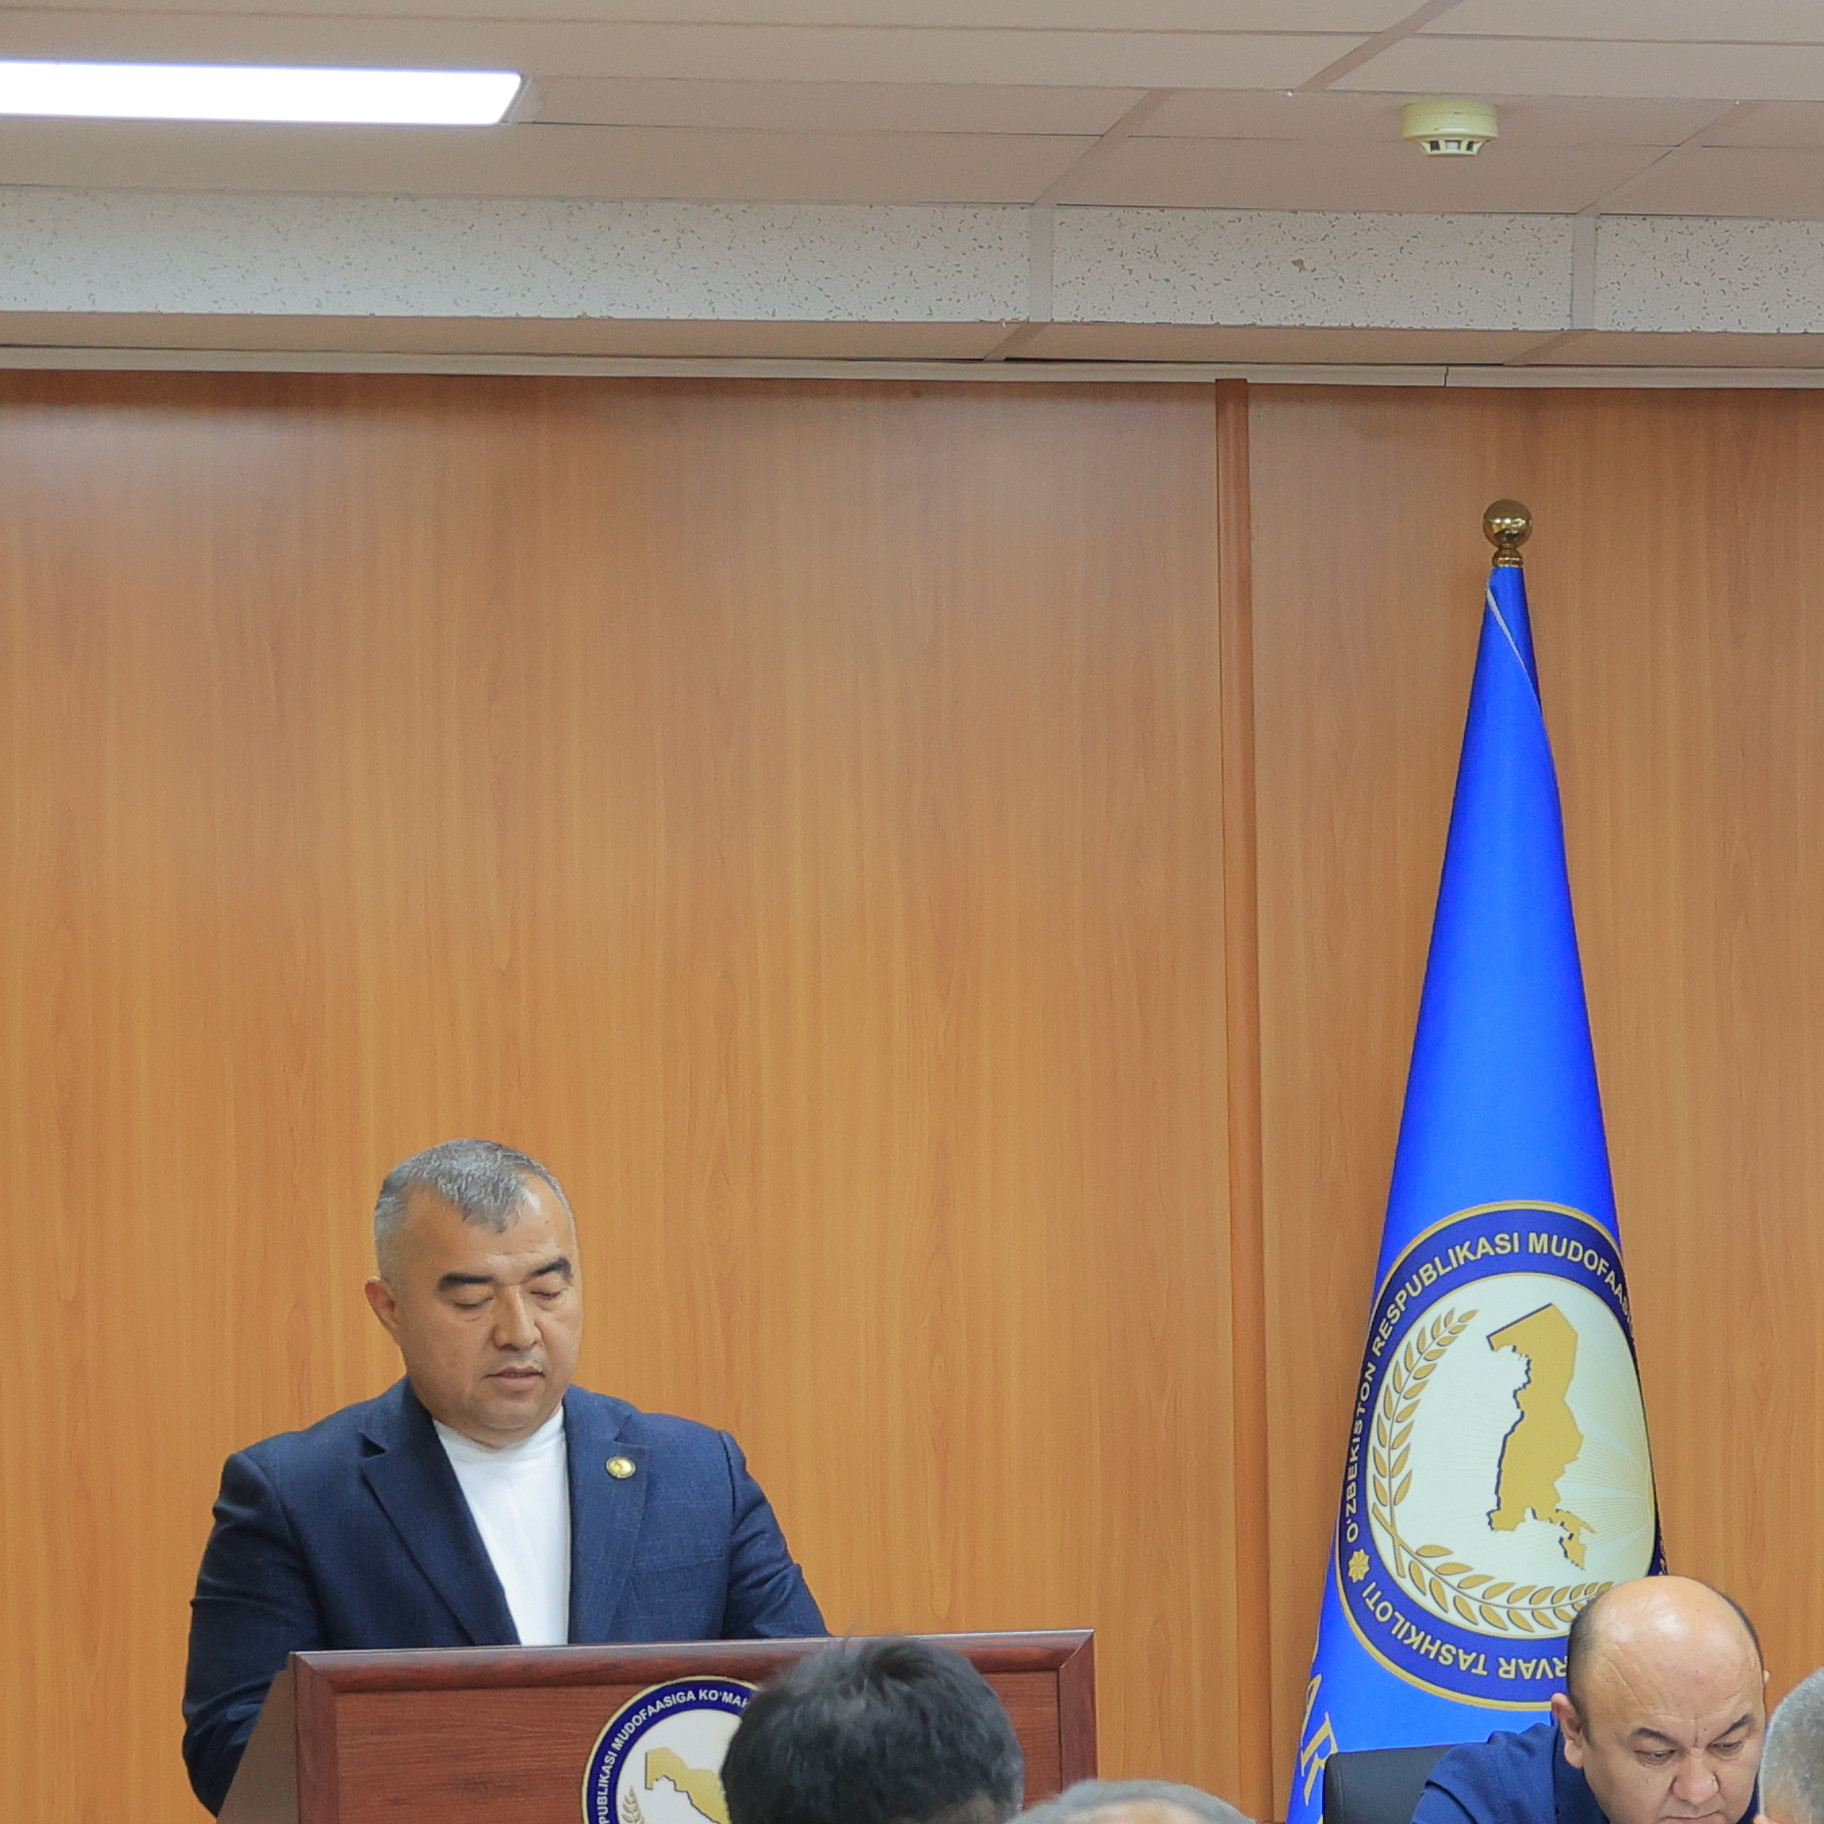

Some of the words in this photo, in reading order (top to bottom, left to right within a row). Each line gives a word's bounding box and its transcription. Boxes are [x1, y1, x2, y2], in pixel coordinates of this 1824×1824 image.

[1371, 1232, 1520, 1356] RESPUBLIKASI
[1361, 1581, 1488, 1676] TASHKILOTI
[612, 1692, 697, 1751] MUDOFAASIGA
